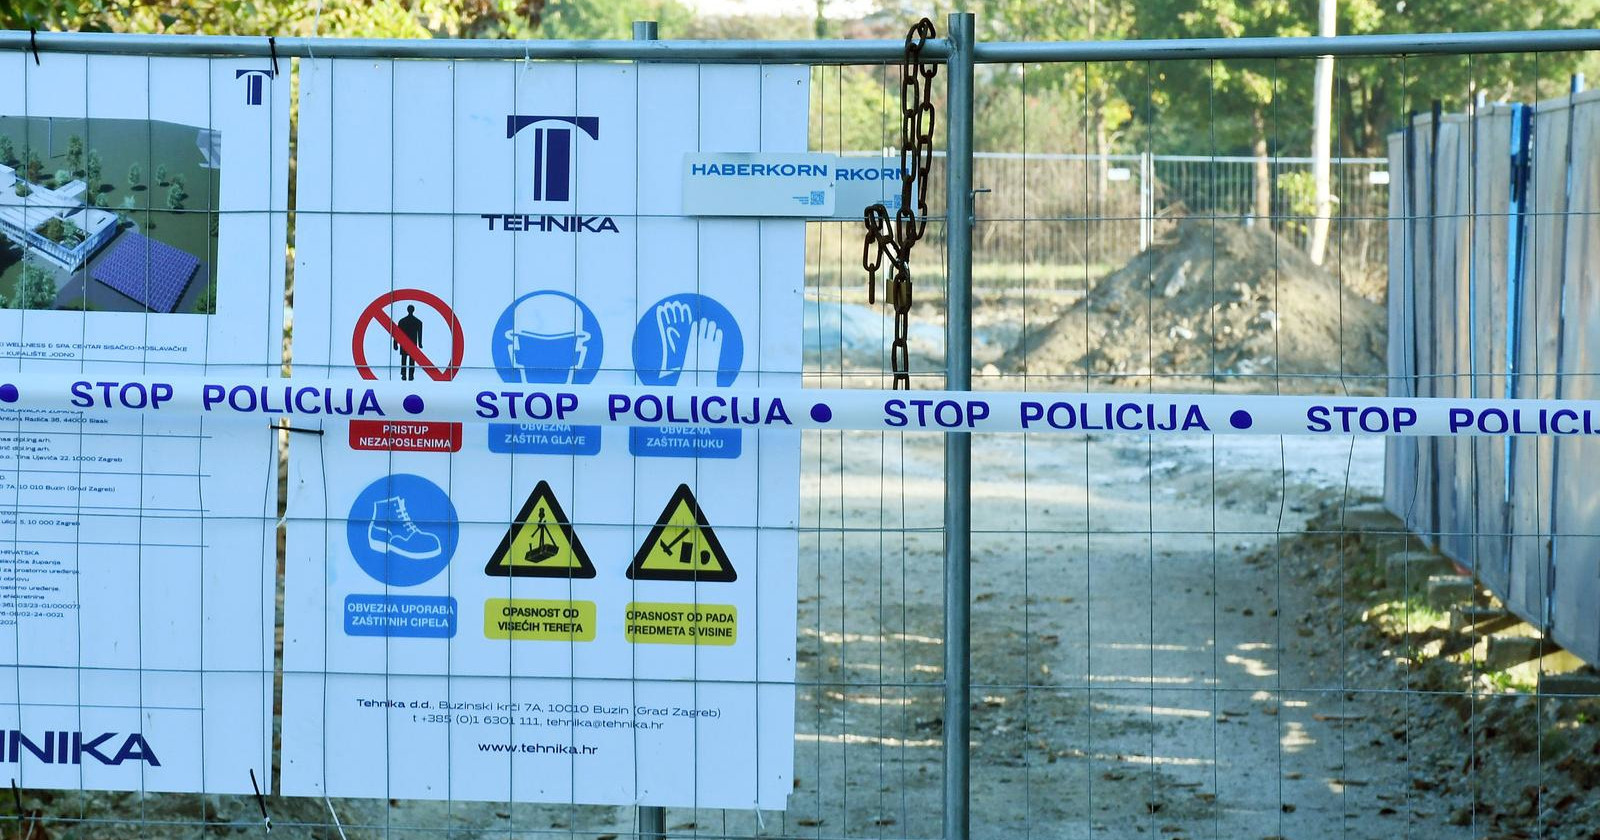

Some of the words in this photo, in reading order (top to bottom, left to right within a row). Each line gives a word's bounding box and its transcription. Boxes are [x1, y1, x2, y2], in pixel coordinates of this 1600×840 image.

[692, 163, 828, 177] HABERKORN
[481, 213, 620, 233] TEHNIKA
[6, 341, 46, 349] WELLNESS
[71, 381, 173, 409] STOP
[203, 383, 386, 416] POLICIJA
[476, 391, 578, 420] STOP
[608, 392, 793, 425] POLICIJA
[884, 399, 990, 428] STOP
[1020, 401, 1211, 431] POLICIJA
[1306, 405, 1417, 433] STOP
[1449, 407, 1600, 434] POLICI
[383, 425, 429, 435] PRISTUP
[359, 437, 452, 449] NEZAPOSLENIMA
[504, 433, 549, 445] ZAŠTITA
[551, 435, 586, 446] GLAVE
[646, 436, 690, 449] ZAŠTITA
[693, 438, 724, 449] RUKU
[347, 602, 399, 613] OBVEZNA
[401, 604, 454, 615] UPORABA
[502, 606, 559, 618] OPASNOST
[562, 608, 579, 619] OD
[352, 614, 408, 627] ZAŠTITNIH
[410, 617, 449, 628] CIPELA
[626, 610, 684, 623] OPASNOST
[686, 612, 703, 622] OD
[706, 613, 734, 623] PADA
[497, 619, 541, 632] VISEĆIH
[543, 622, 583, 633] TERETA
[627, 625, 685, 637] PREDMETA
[688, 626, 696, 637] S
[697, 627, 733, 638] VISINE
[356, 699, 406, 709] Tehnika
[438, 700, 493, 712] Buzinski
[524, 703, 544, 714] 7A,
[548, 704, 589, 714] 10010
[593, 704, 629, 715] Buzin
[633, 706, 669, 718] (Grad
[672, 706, 721, 720] Zagreb)
[412, 714, 417, 723] t
[421, 714, 452, 724] +385
[455, 714, 479, 726] (0)1
[483, 715, 516, 726] 6301
[546, 718, 664, 730] tehnika@tehnika.hr
[477, 743, 599, 755] www.tehnika.hr
